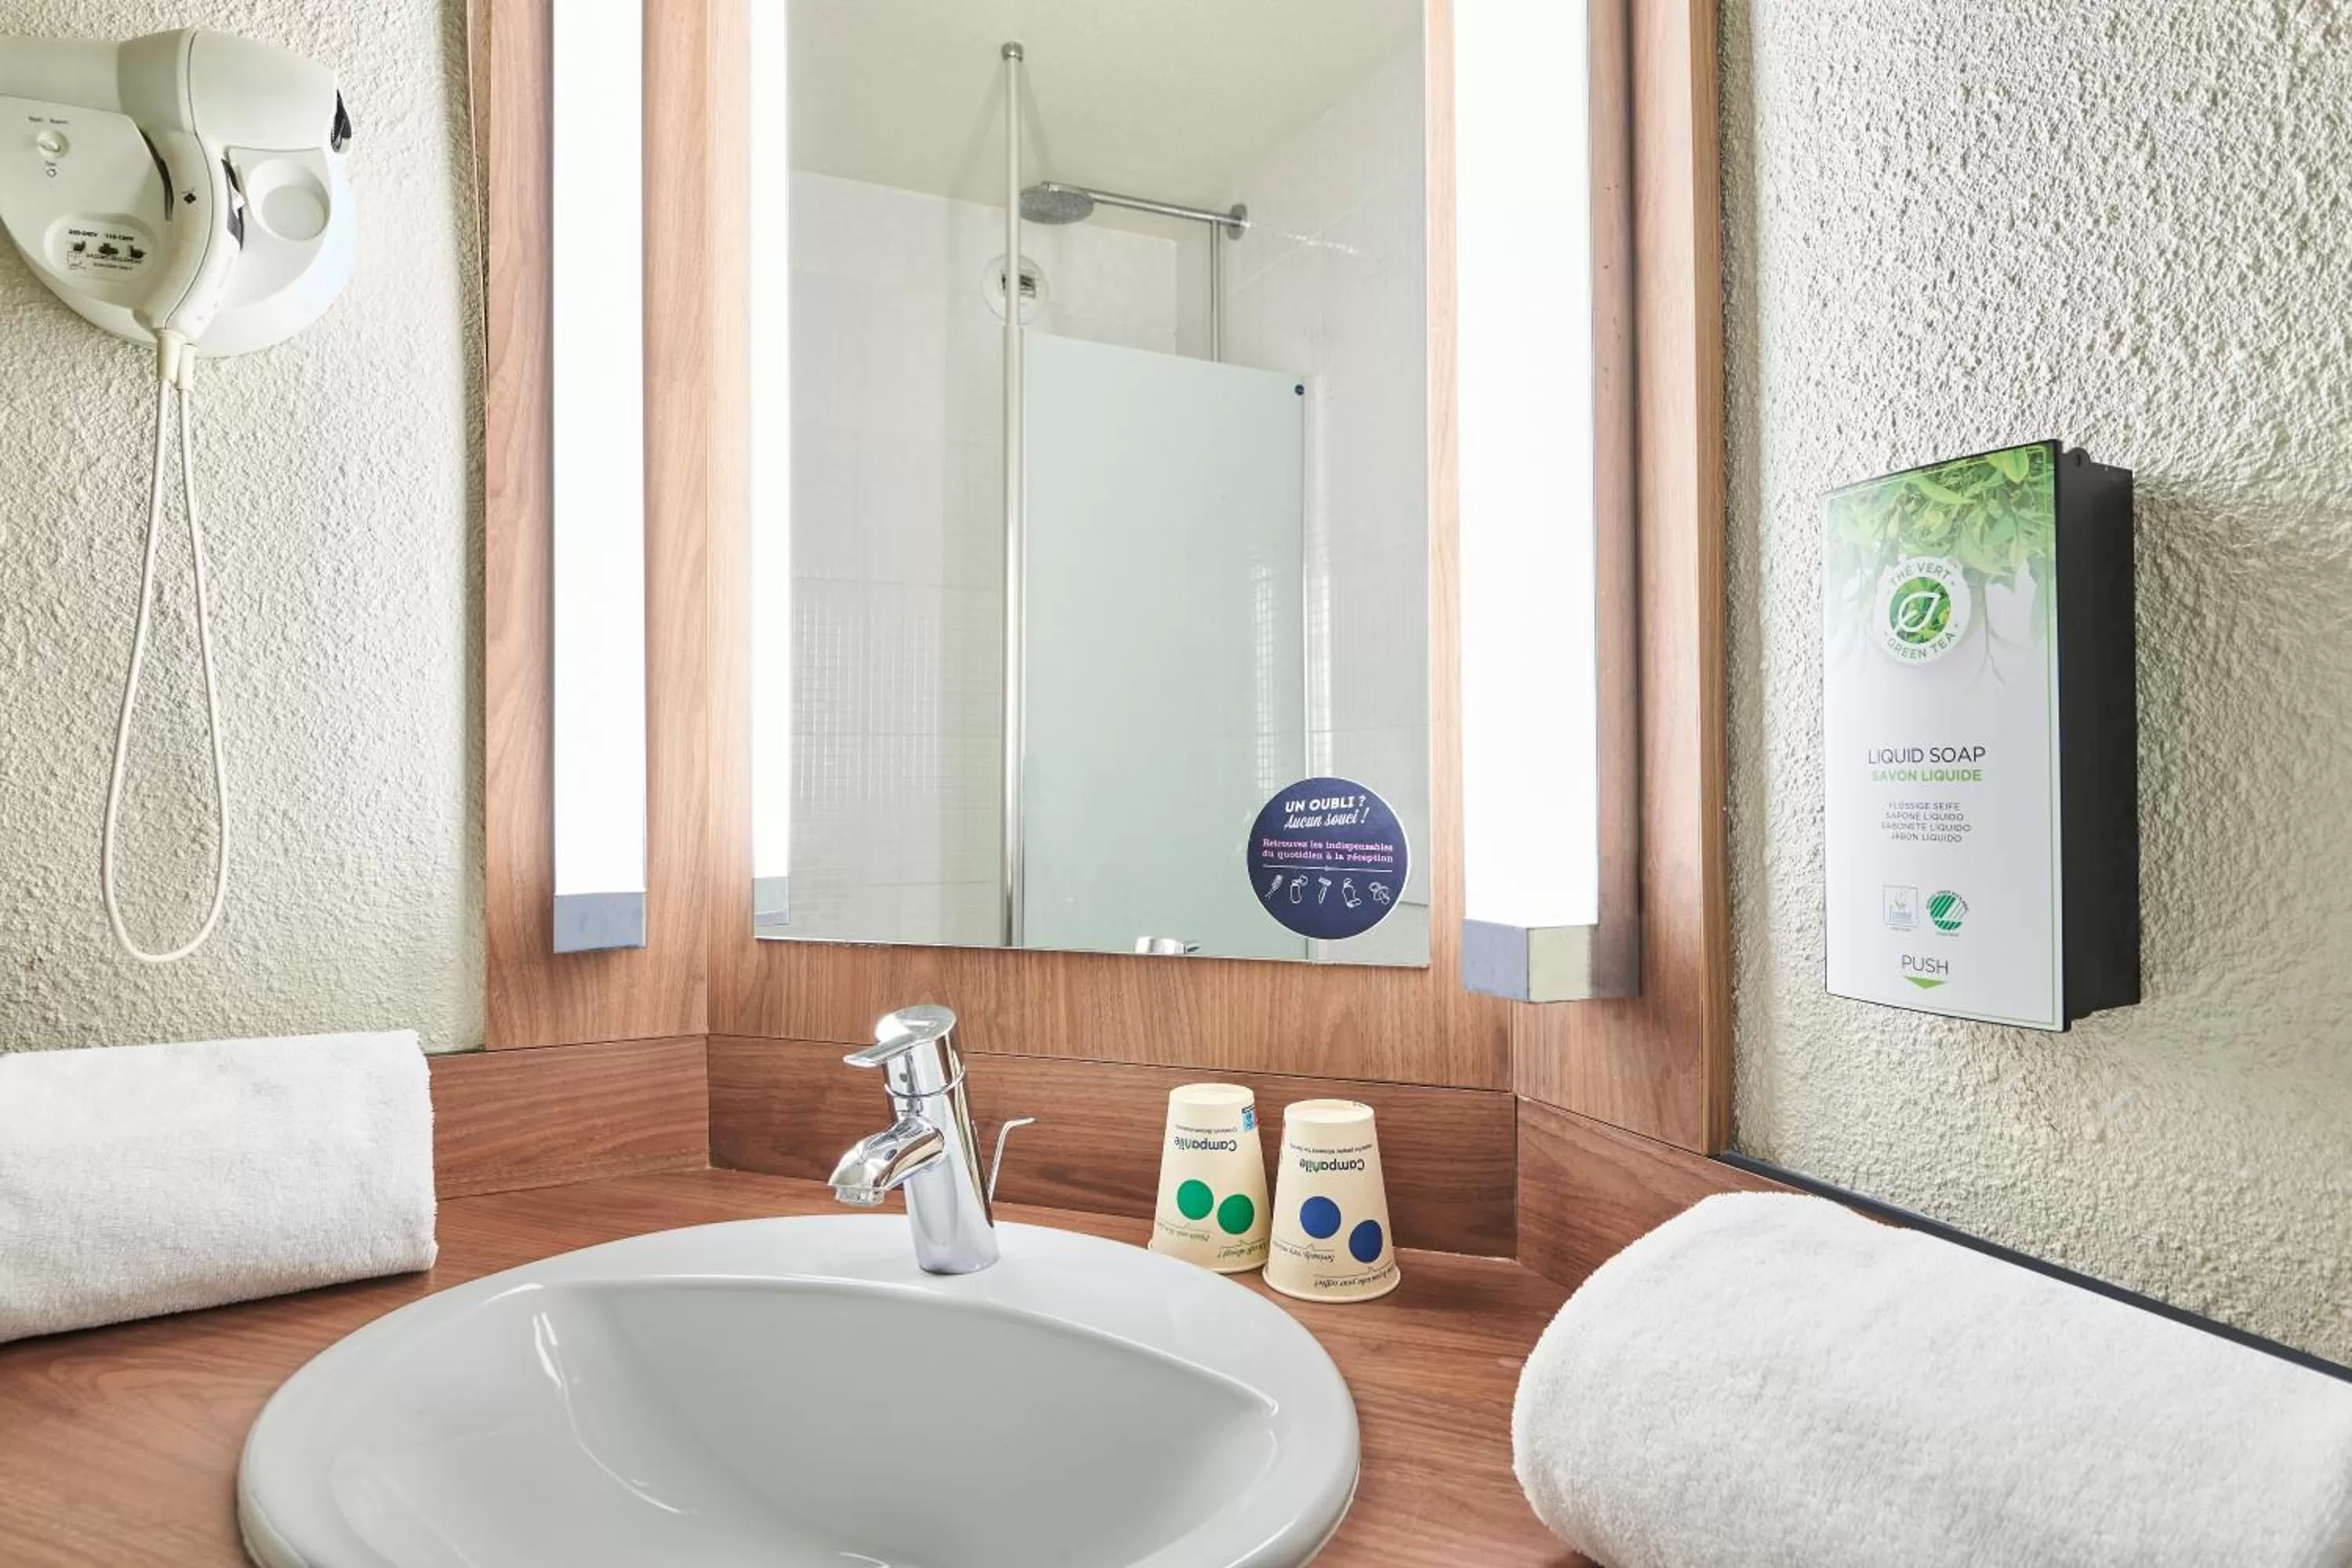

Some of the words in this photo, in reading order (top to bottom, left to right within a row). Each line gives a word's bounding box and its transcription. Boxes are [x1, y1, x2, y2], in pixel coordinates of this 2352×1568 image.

[1918, 562, 1951, 579] VERT
[1887, 637, 1926, 659] GREEN
[1929, 632, 1957, 653] TEA
[1868, 747, 1924, 765] LIQUID
[1929, 746, 1987, 763] SOAP
[1872, 769, 1917, 782] SAVON
[1922, 769, 1983, 782] LIQUIDE
[1285, 800, 1305, 813] UN
[1308, 797, 1356, 811] OUBLI
[1359, 795, 1367, 808] ?
[1932, 801, 1961, 811] SEIFE
[1284, 815, 1323, 830] Aucun
[1324, 809, 1359, 828] souci
[1361, 807, 1370, 824] !
[1884, 811, 1921, 821] SAPONE
[1923, 812, 1964, 822] LIQUIDO
[1262, 838, 1308, 848] Retrouvez
[1310, 840, 1323, 850] les
[1326, 841, 1393, 852] indispensables
[1262, 850, 1274, 858] du
[1277, 851, 1323, 861] quotidien
[1326, 851, 1333, 860] à
[1335, 852, 1345, 861] la
[1346, 852, 1393, 863] réception
[1901, 954, 1949, 976] PUSH
[1174, 1136, 1237, 1152] Campanile
[1299, 1158, 1365, 1173] Campanile
